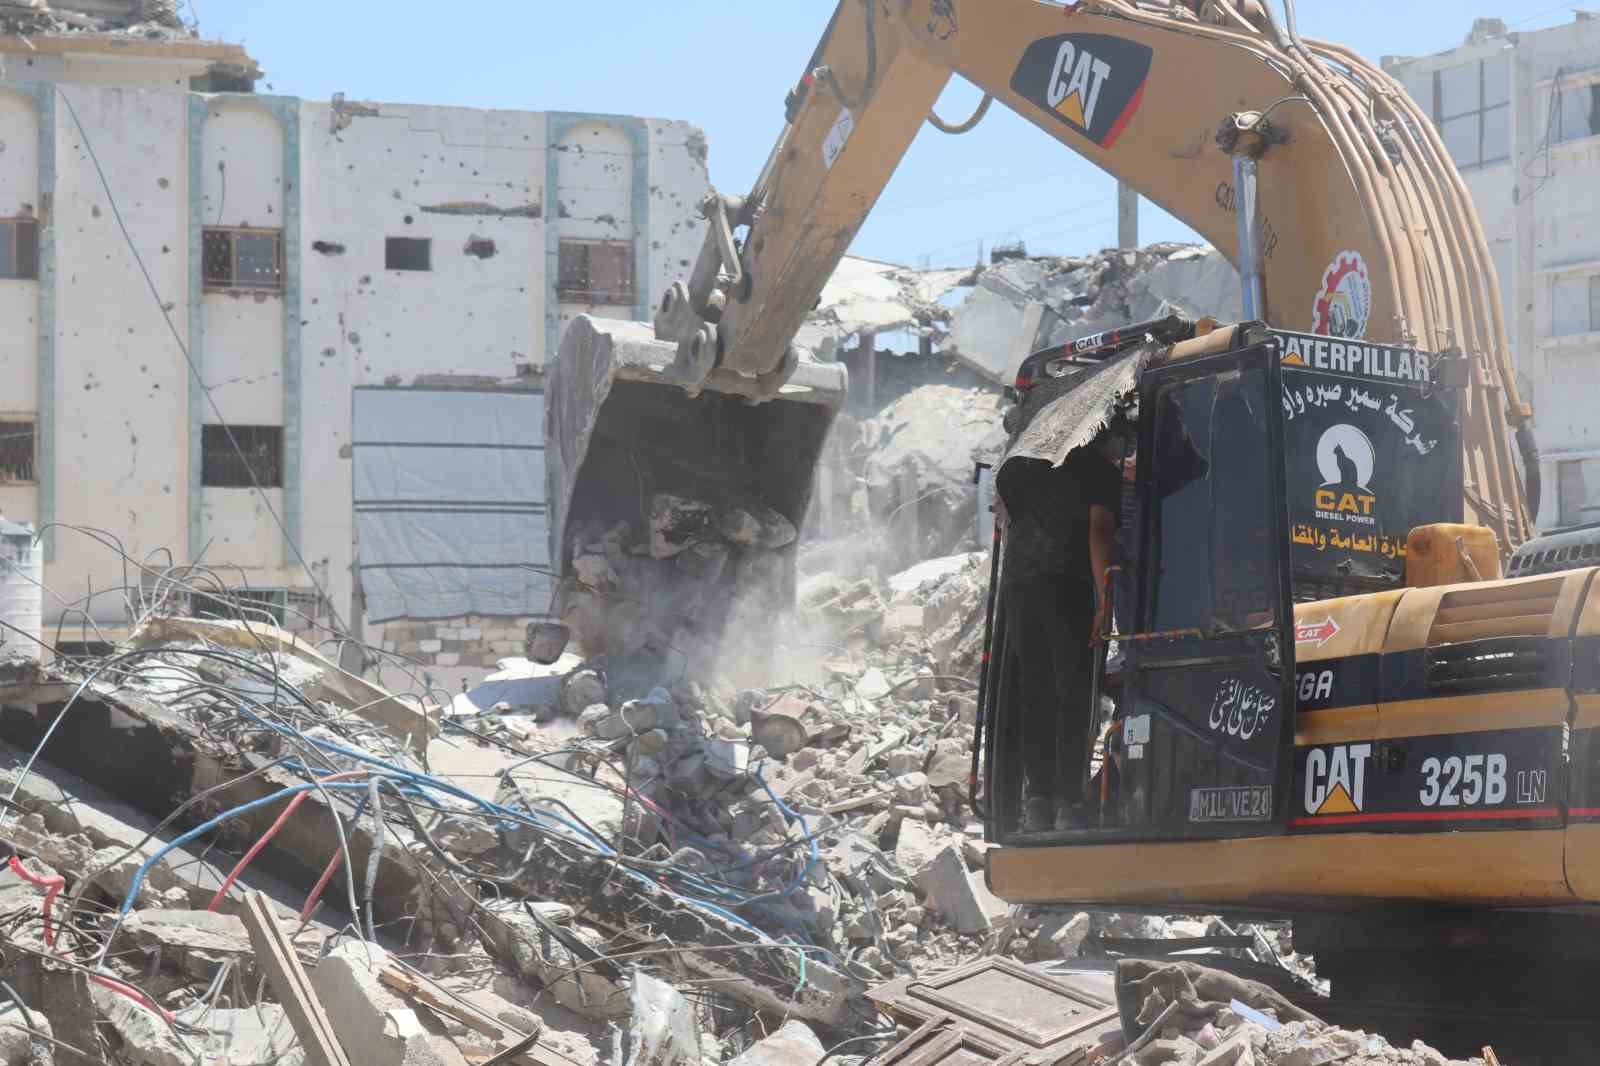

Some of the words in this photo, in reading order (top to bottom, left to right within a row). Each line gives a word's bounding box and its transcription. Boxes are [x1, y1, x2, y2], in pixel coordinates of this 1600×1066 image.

[1047, 40, 1111, 131] CAT
[1272, 335, 1431, 382] CATERPILLAR
[1344, 387, 1382, 411] سمير
[1385, 393, 1438, 456] شركة
[1315, 490, 1376, 514] CAT
[1315, 510, 1344, 521] DIESEL
[1345, 512, 1375, 525] POWER
[1330, 528, 1377, 553] العامة
[1297, 628, 1321, 639] CAT
[1304, 744, 1371, 815] CAT
[1419, 753, 1507, 807] 325B
[1516, 770, 1546, 804] LN
